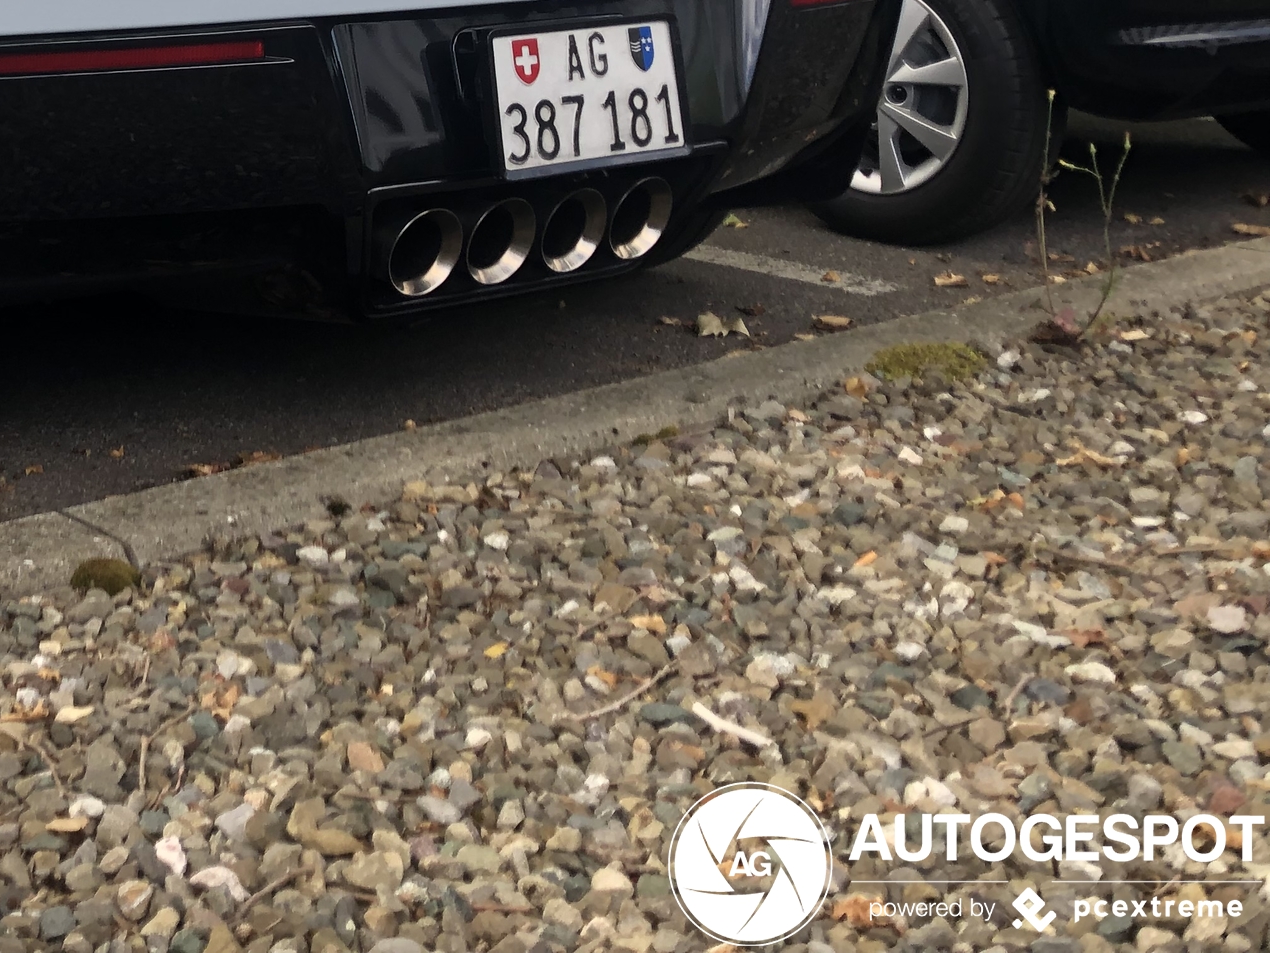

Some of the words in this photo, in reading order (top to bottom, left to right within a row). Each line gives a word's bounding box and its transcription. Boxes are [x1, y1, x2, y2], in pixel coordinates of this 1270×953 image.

[568, 31, 609, 81] AG
[505, 94, 584, 165] 387
[602, 84, 679, 151] 181
